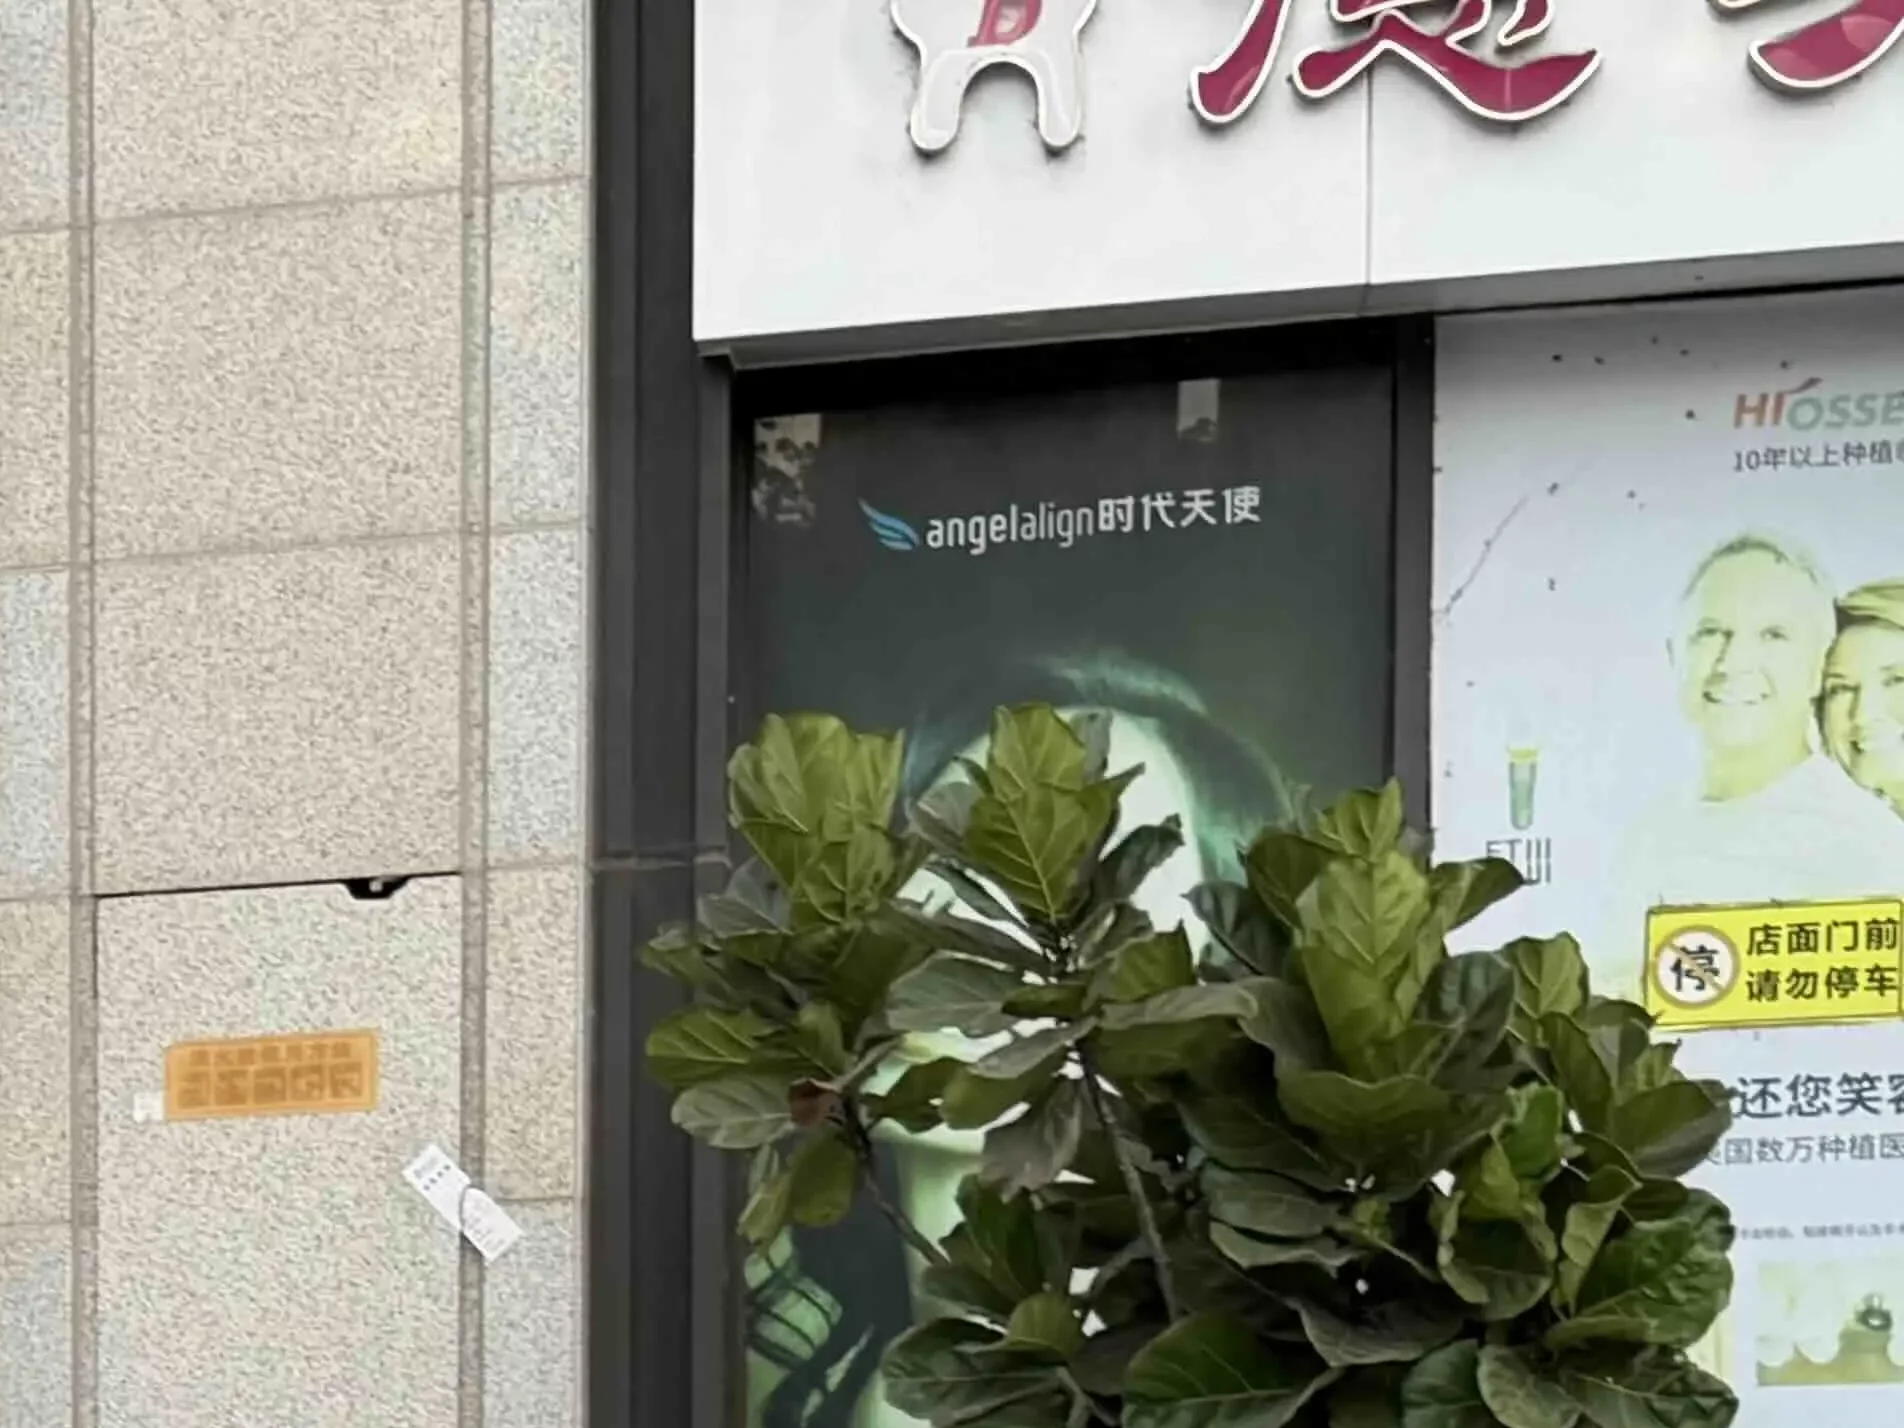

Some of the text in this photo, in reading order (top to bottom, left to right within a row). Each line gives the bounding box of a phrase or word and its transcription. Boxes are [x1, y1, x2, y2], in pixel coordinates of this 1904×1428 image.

[1747, 917, 1899, 957] 店面门前
[1745, 964, 1900, 1004] 请勿停车
[1708, 1131, 1904, 1167] 国数万种植医
